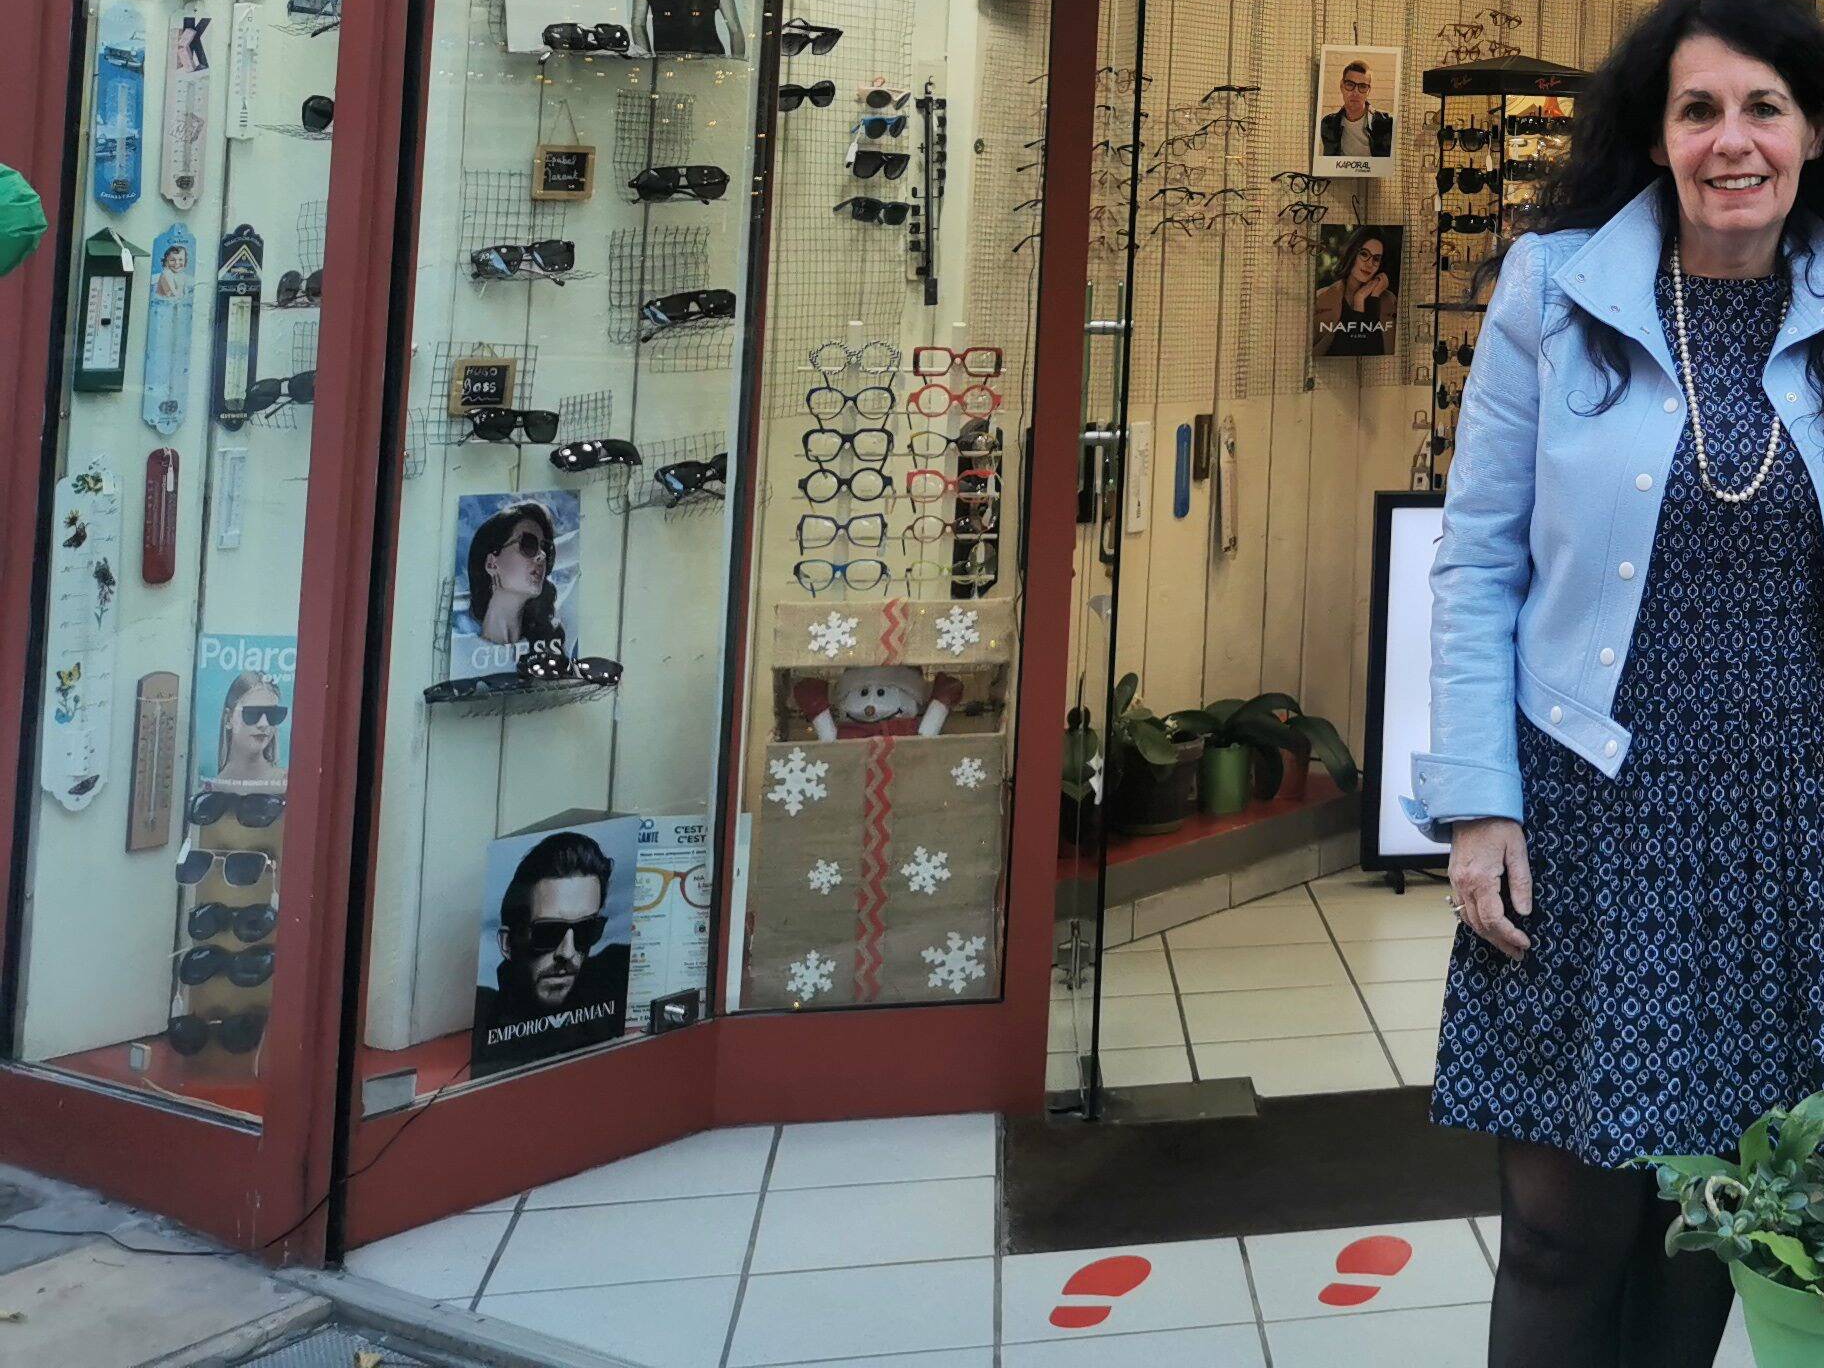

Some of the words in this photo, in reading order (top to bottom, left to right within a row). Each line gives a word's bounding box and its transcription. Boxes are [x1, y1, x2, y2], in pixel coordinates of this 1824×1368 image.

[1320, 320, 1357, 333] NAF
[1360, 320, 1393, 333] NAF
[487, 1014, 551, 1045] EMPORIO
[566, 1000, 616, 1026] ARMANI
